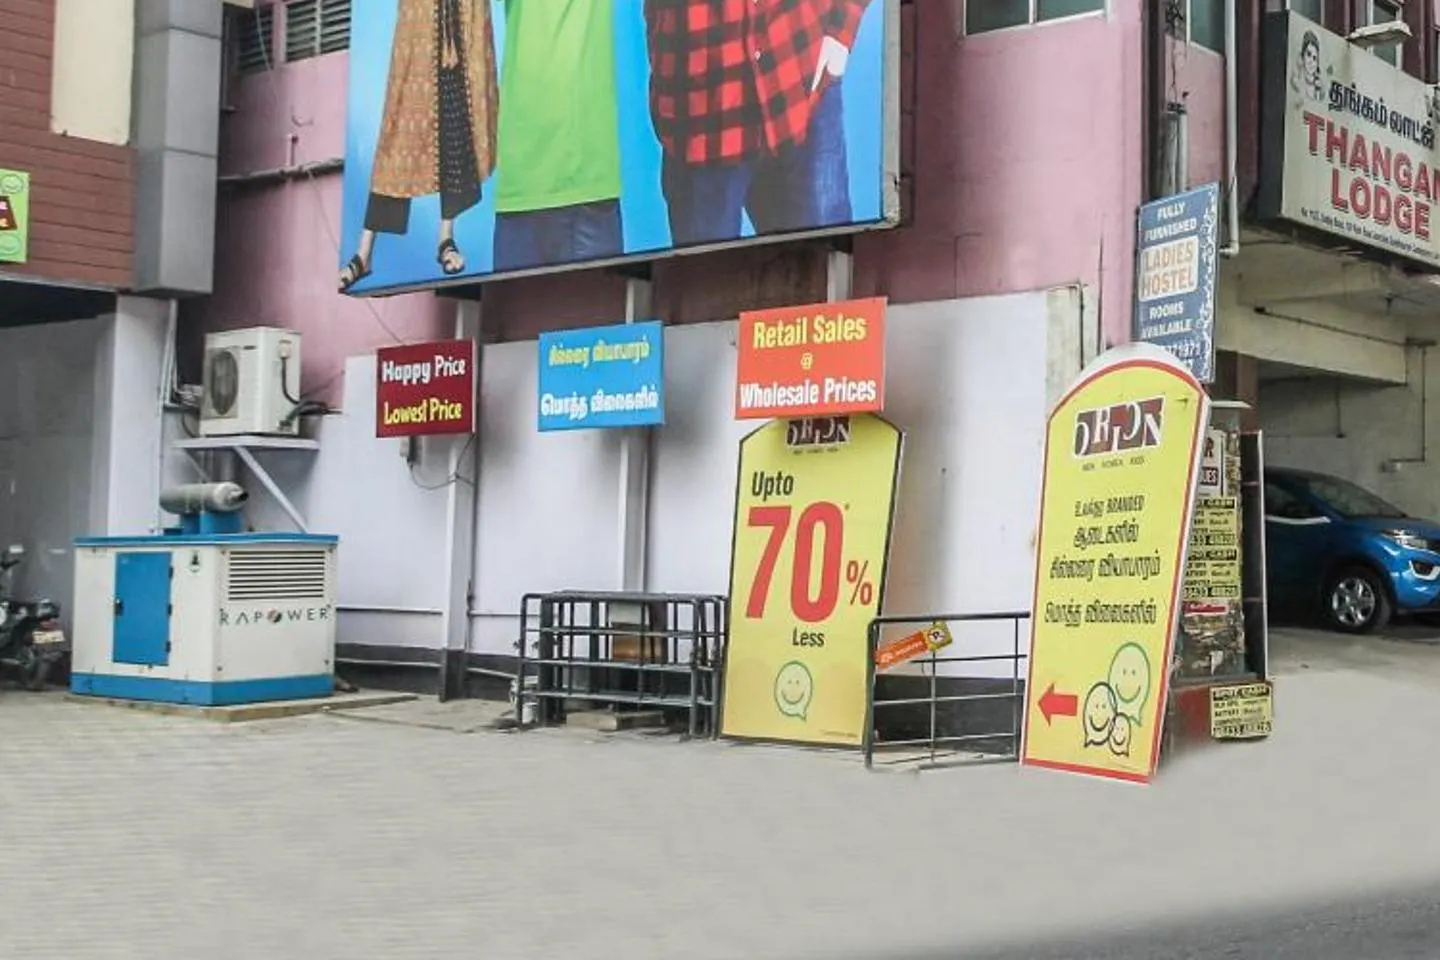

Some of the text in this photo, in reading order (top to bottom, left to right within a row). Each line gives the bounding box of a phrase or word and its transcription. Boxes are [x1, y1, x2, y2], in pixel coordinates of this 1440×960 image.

[1328, 80, 1388, 129] தங்கம்
[1157, 201, 1187, 222] FULLY
[1331, 167, 1431, 242] LODGE
[1142, 240, 1194, 270] LADIES
[1140, 269, 1195, 299] HOSTEL
[1149, 300, 1185, 320] ROOMS
[752, 312, 867, 349] Retail Sales
[382, 354, 467, 386] Happy Price
[740, 375, 877, 409] Wholesale Prices
[383, 397, 462, 425] Lowest Price
[1074, 397, 1163, 457] ORION
[751, 471, 795, 503] Upto
[1106, 494, 1145, 514] BRANDED
[792, 626, 826, 648] Less
